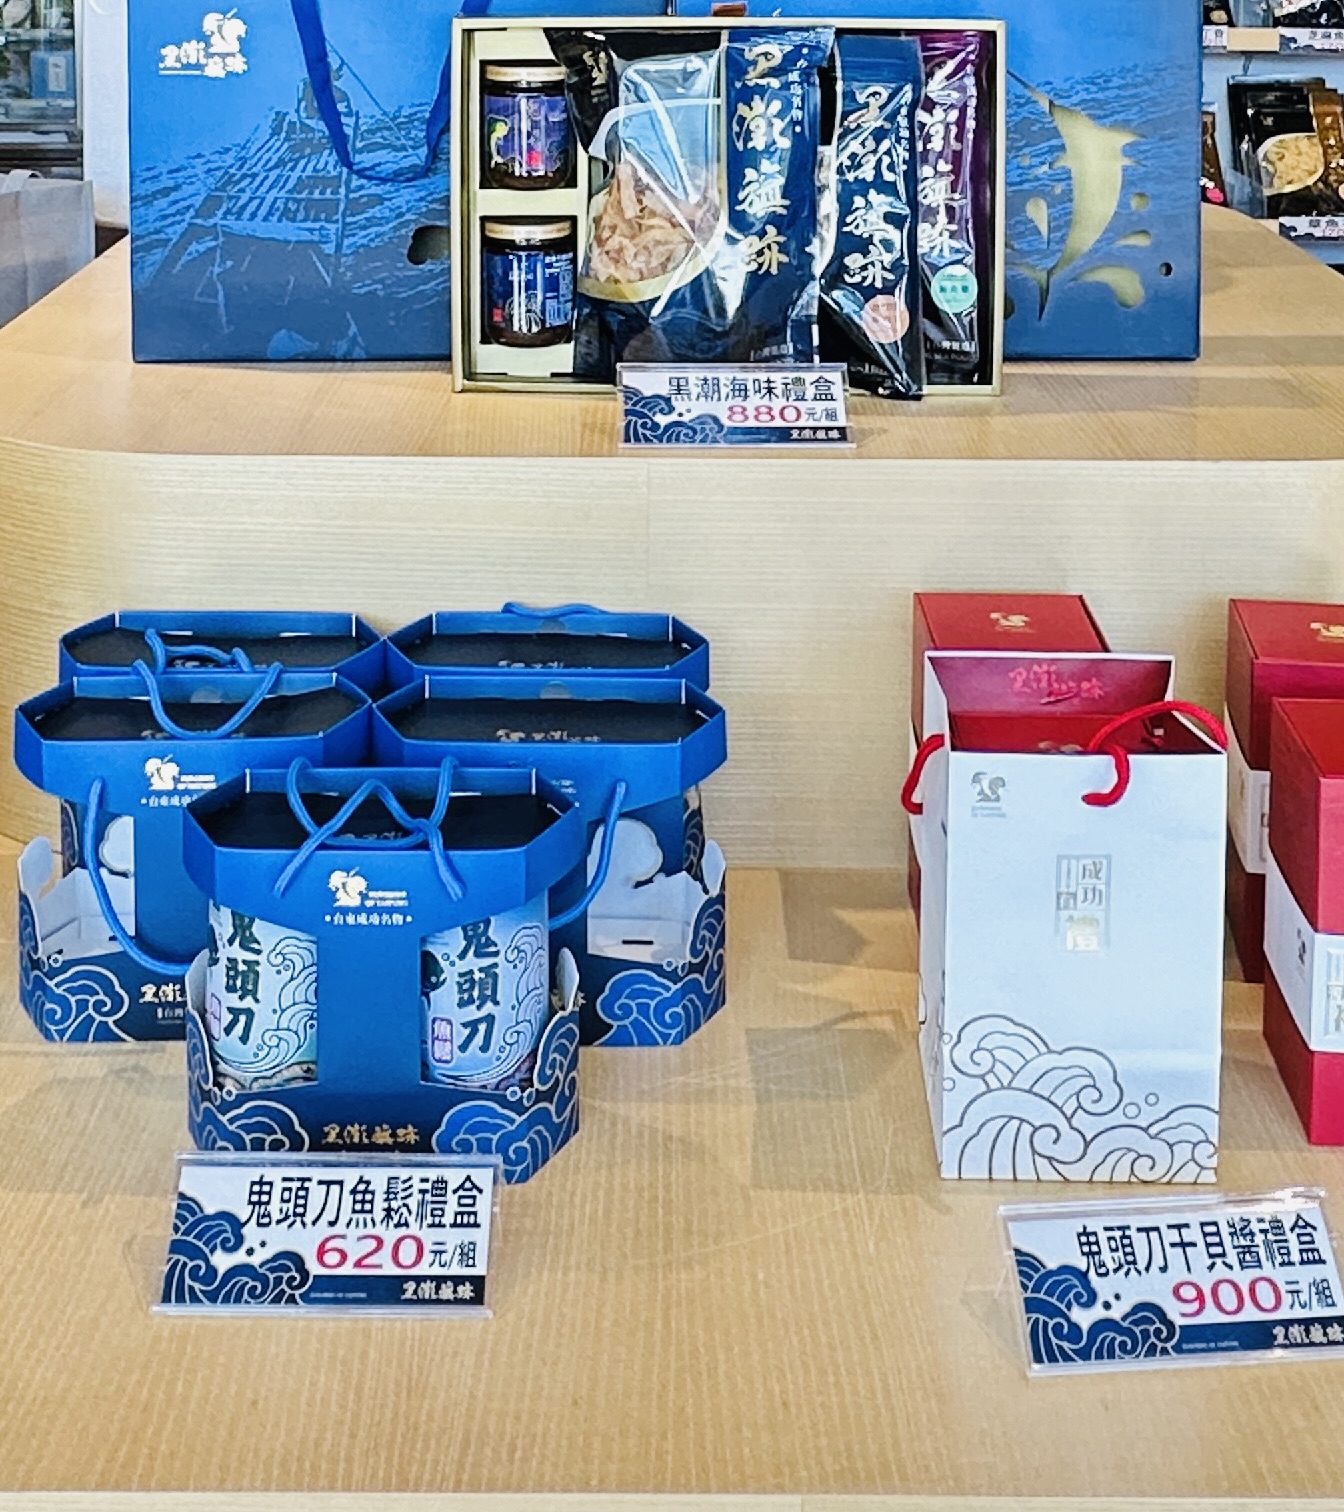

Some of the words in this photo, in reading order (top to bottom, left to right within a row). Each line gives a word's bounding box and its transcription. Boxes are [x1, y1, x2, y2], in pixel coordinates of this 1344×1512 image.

[667, 375, 838, 403] 黑潮海味禮盒
[242, 1174, 484, 1231] 鬼頭刀魚鬆禮盒
[1075, 1213, 1328, 1280] 鬼頭刀干貝醬禮盒
